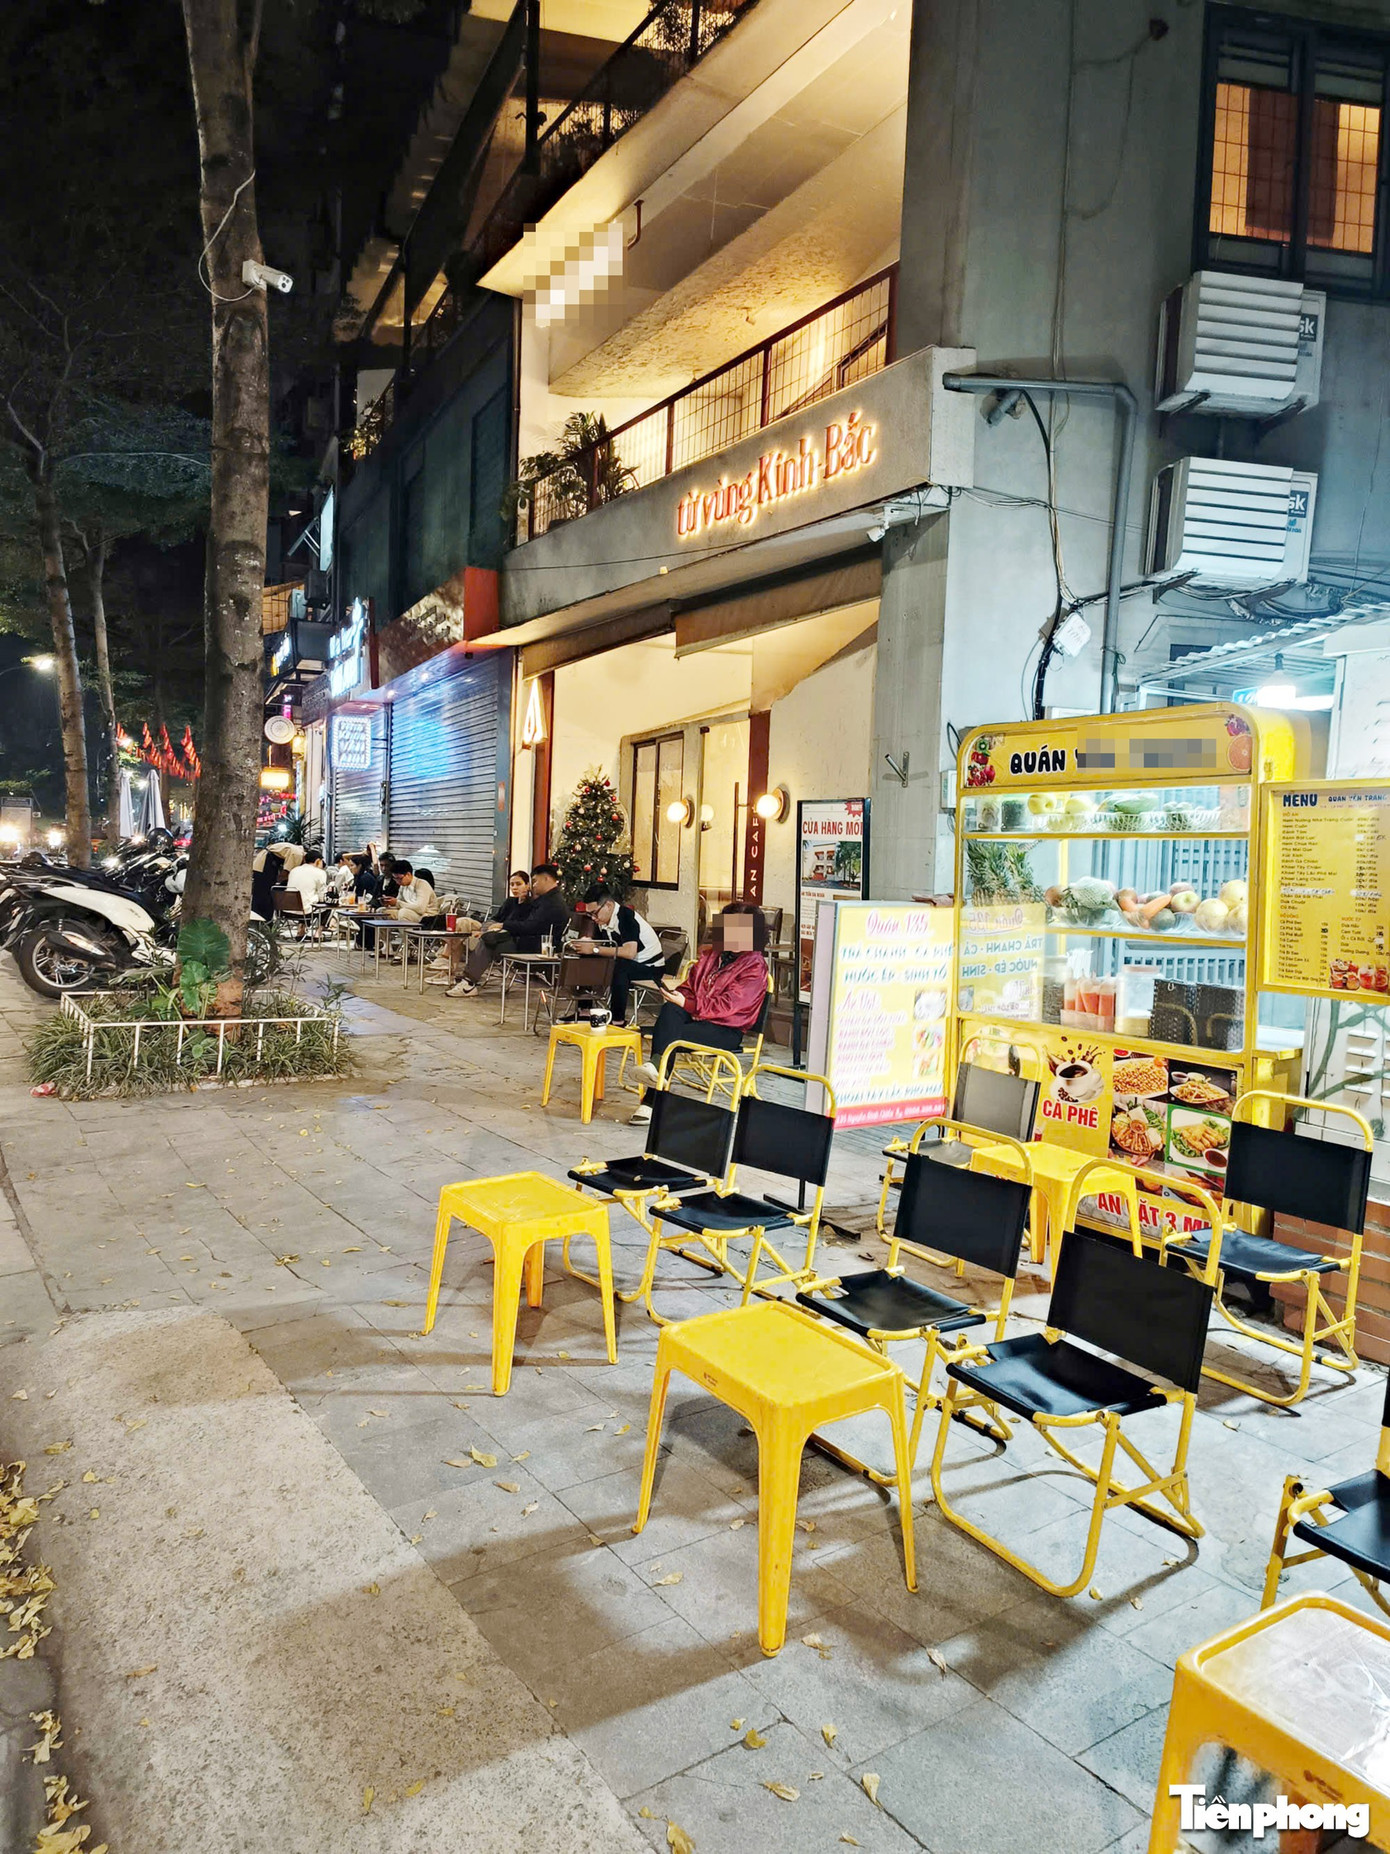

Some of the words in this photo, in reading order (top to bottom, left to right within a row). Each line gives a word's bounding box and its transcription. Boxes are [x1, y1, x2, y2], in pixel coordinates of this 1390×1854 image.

[1010, 744, 1066, 774] QUÁN
[1282, 793, 1318, 808] MENU
[802, 816, 819, 835] CỬA
[821, 818, 843, 835] HÀNG
[1042, 1097, 1063, 1120] CÀ
[1067, 1105, 1098, 1128] PHÊ
